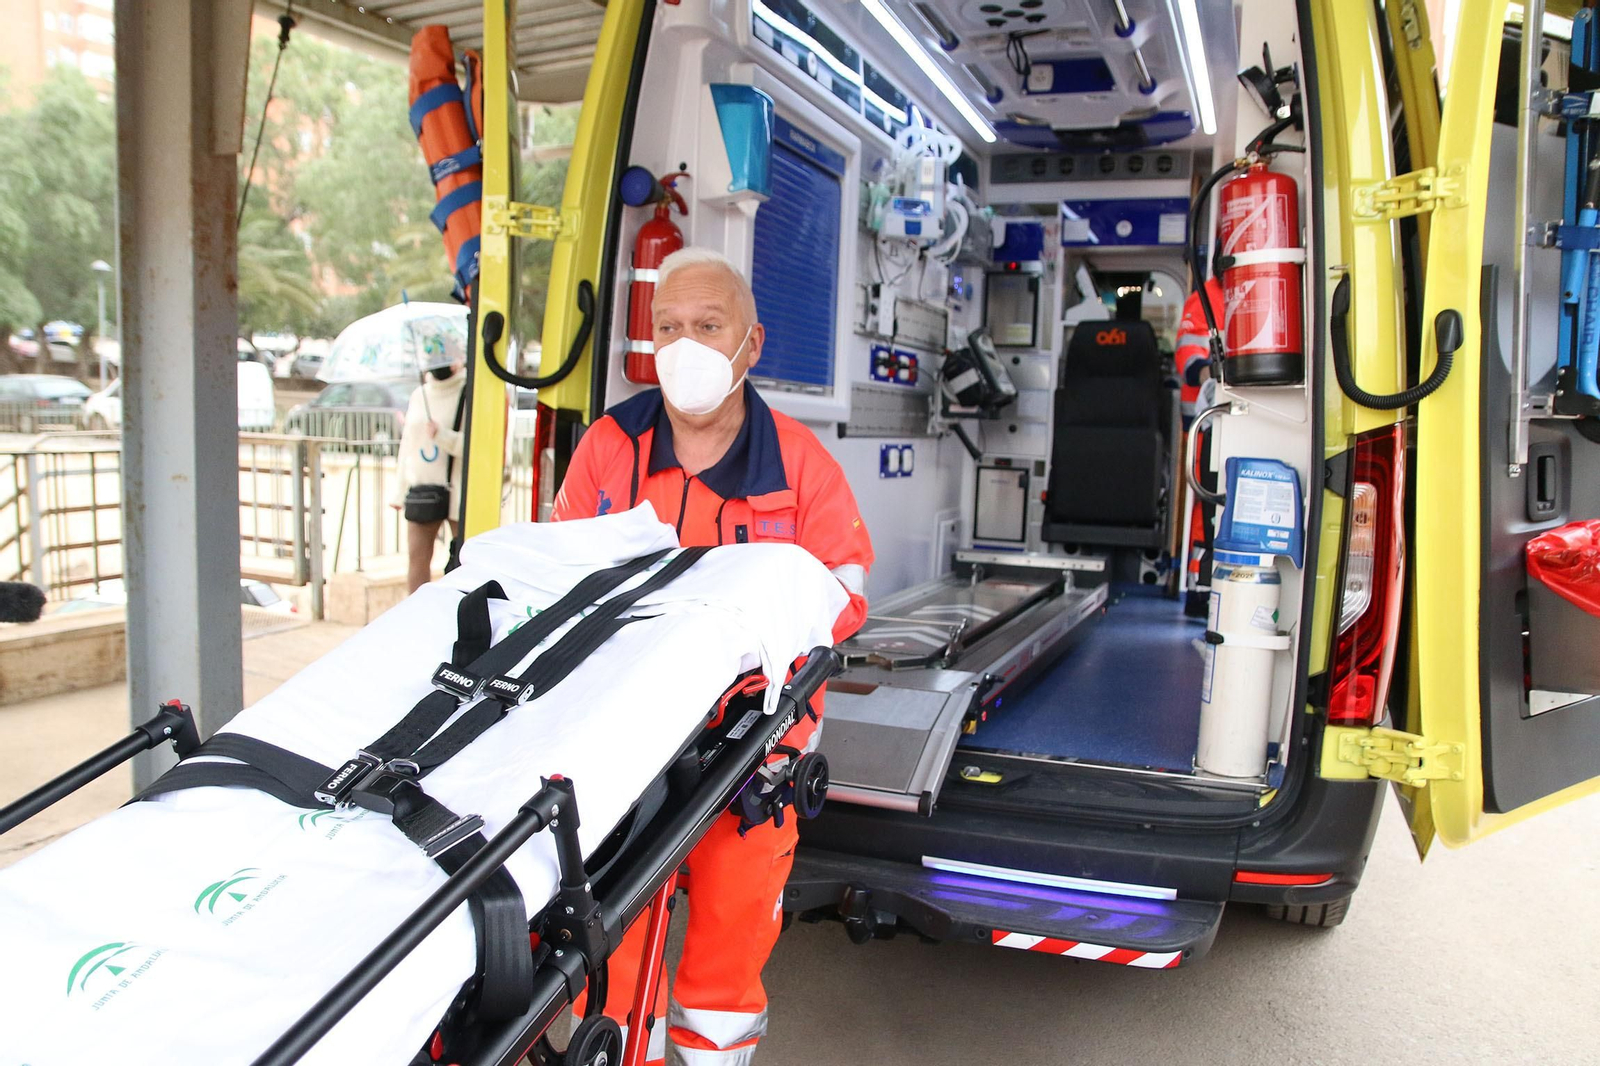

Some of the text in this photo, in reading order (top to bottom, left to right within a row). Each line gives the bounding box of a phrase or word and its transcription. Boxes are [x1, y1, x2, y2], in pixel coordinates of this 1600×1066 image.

[1583, 286, 1598, 345] CHAIR
[1241, 469, 1274, 478] KALINOX
[439, 669, 474, 688] FERNO
[489, 679, 520, 692] FERNO
[765, 711, 795, 756] MONDIAL
[327, 763, 358, 789] FERNO
[92, 989, 120, 1011] JUNTA
[118, 979, 132, 988] DE
